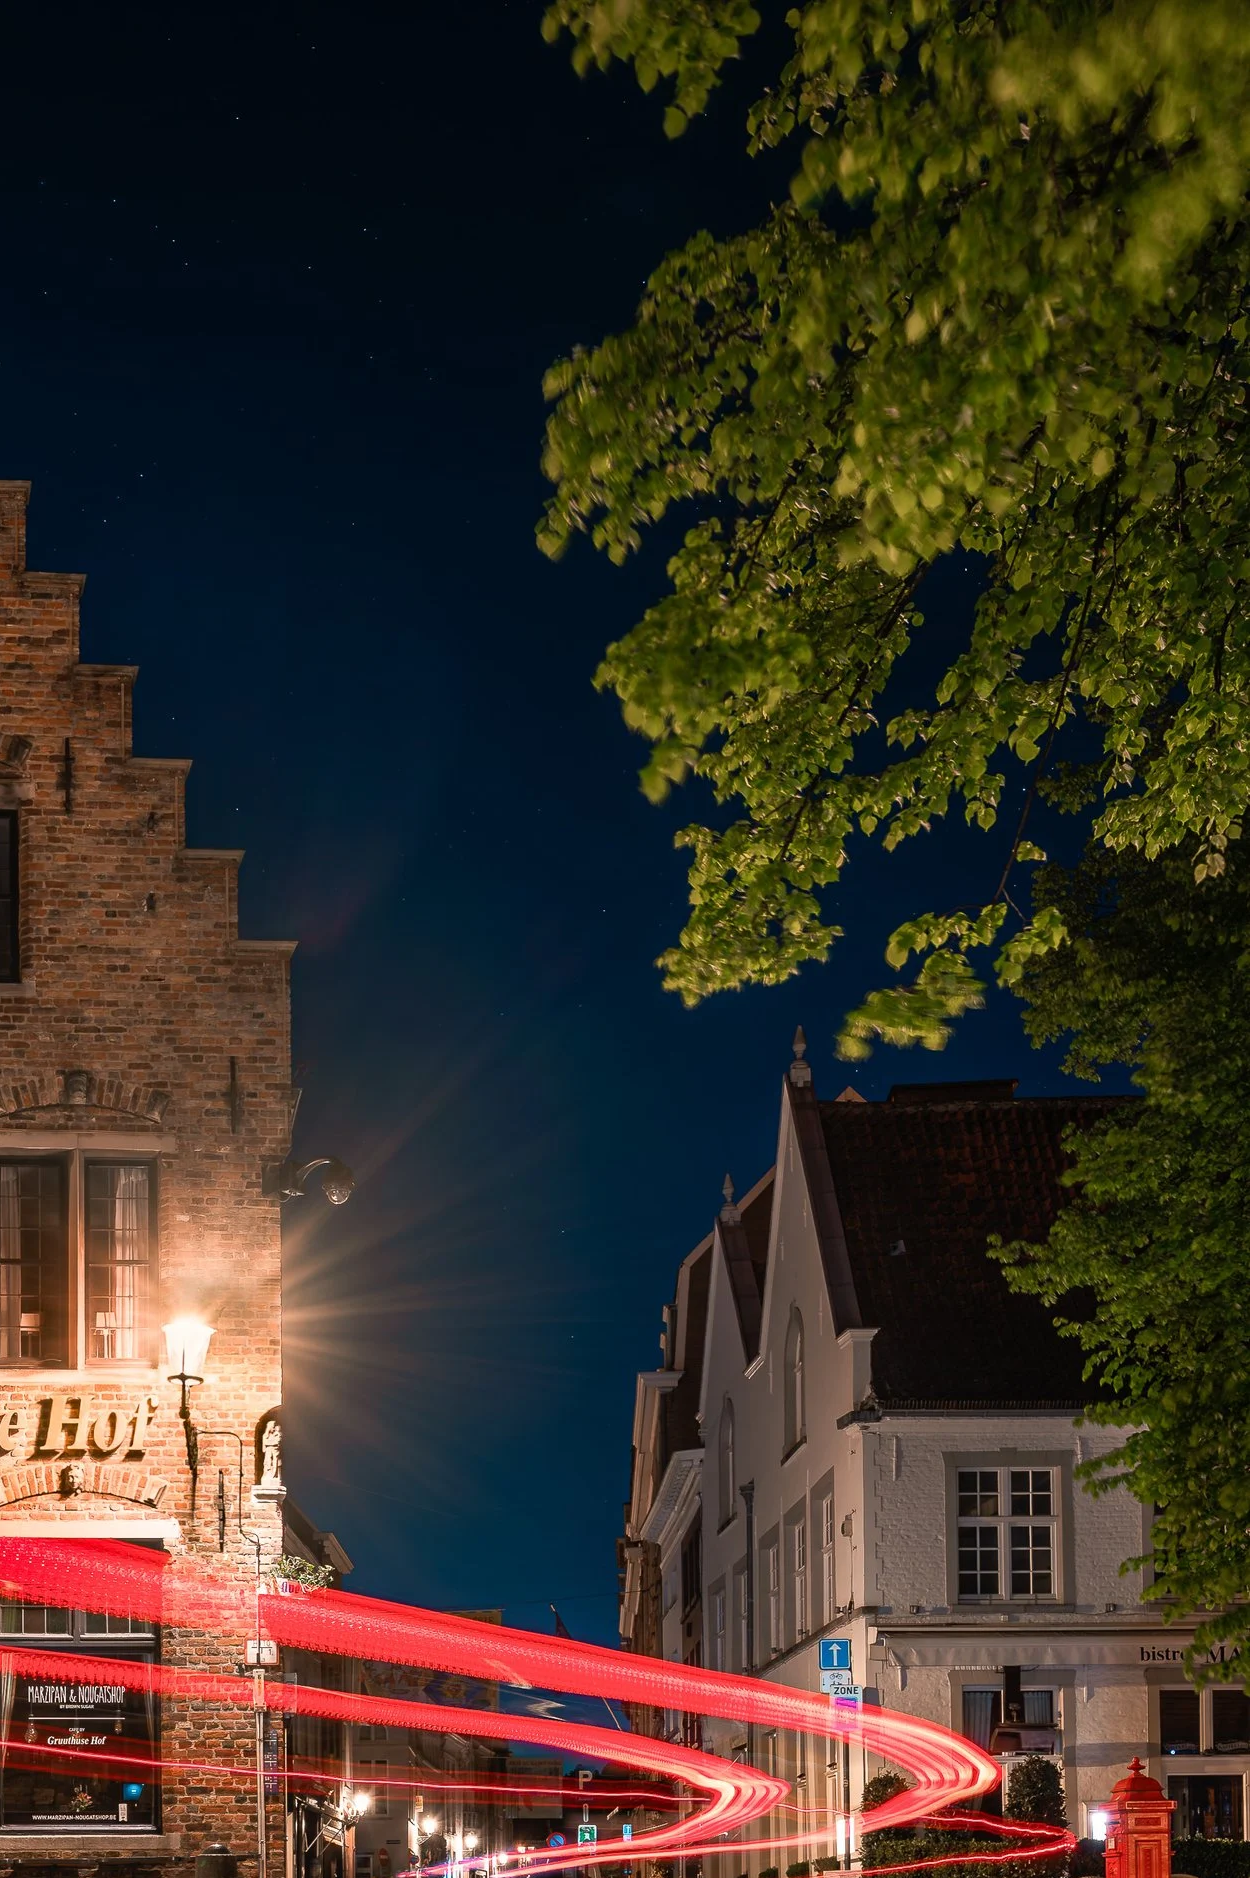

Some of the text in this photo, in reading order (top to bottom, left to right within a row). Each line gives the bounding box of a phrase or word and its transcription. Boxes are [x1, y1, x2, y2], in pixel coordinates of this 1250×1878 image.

[39, 1394, 159, 1453] Hof
[28, 1685, 126, 1704] MARZIPAN & NOUGATSHOP
[834, 1686, 859, 1695] ZONE
[47, 1735, 107, 1745] Gruuthuse Hof
